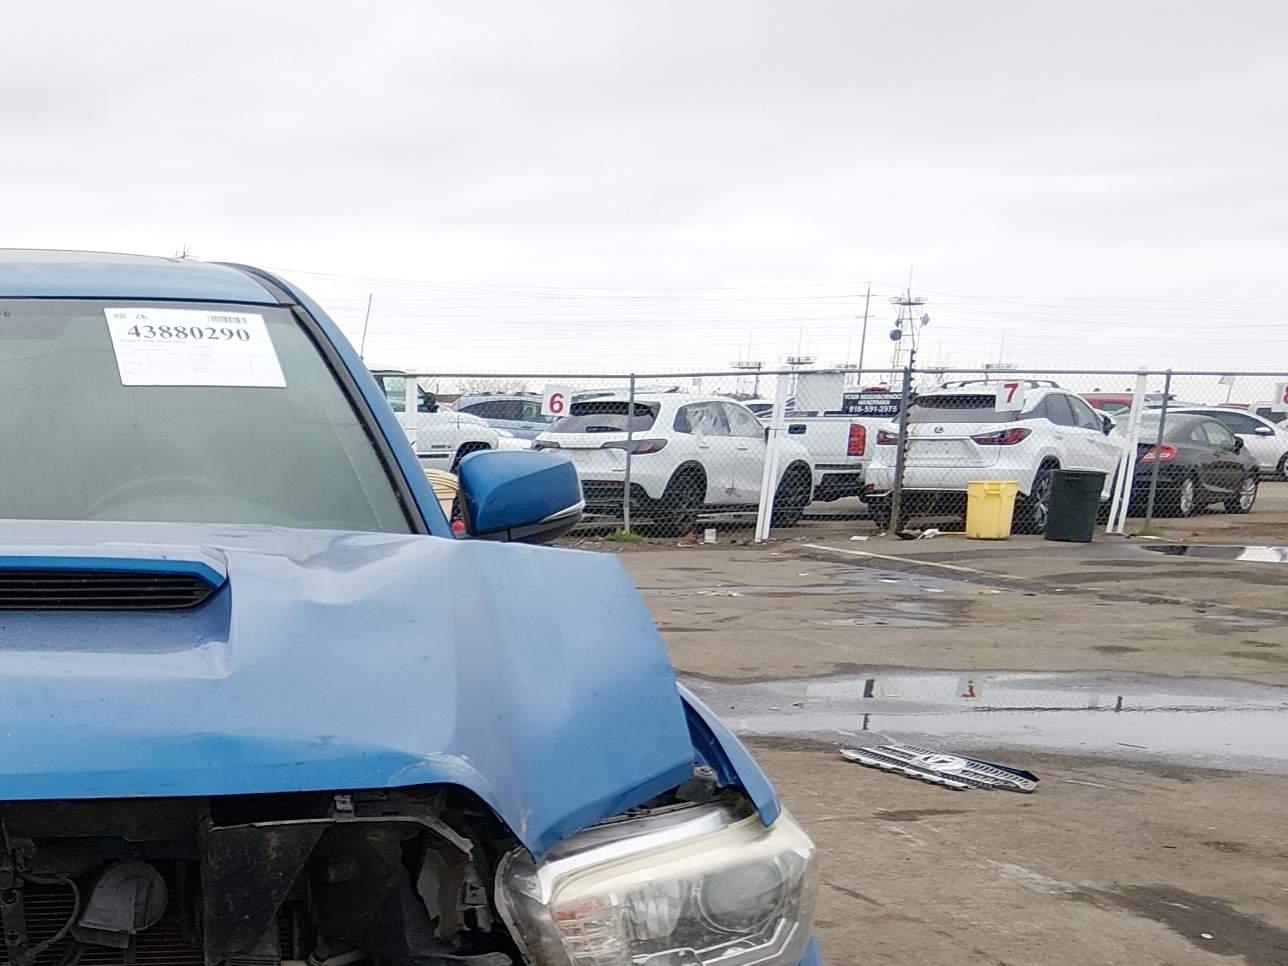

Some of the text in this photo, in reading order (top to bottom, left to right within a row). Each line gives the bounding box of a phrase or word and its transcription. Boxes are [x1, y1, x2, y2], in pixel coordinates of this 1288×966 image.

[127, 325, 250, 342] 43880290
[1003, 383, 1018, 403] 7
[549, 393, 564, 414] 6
